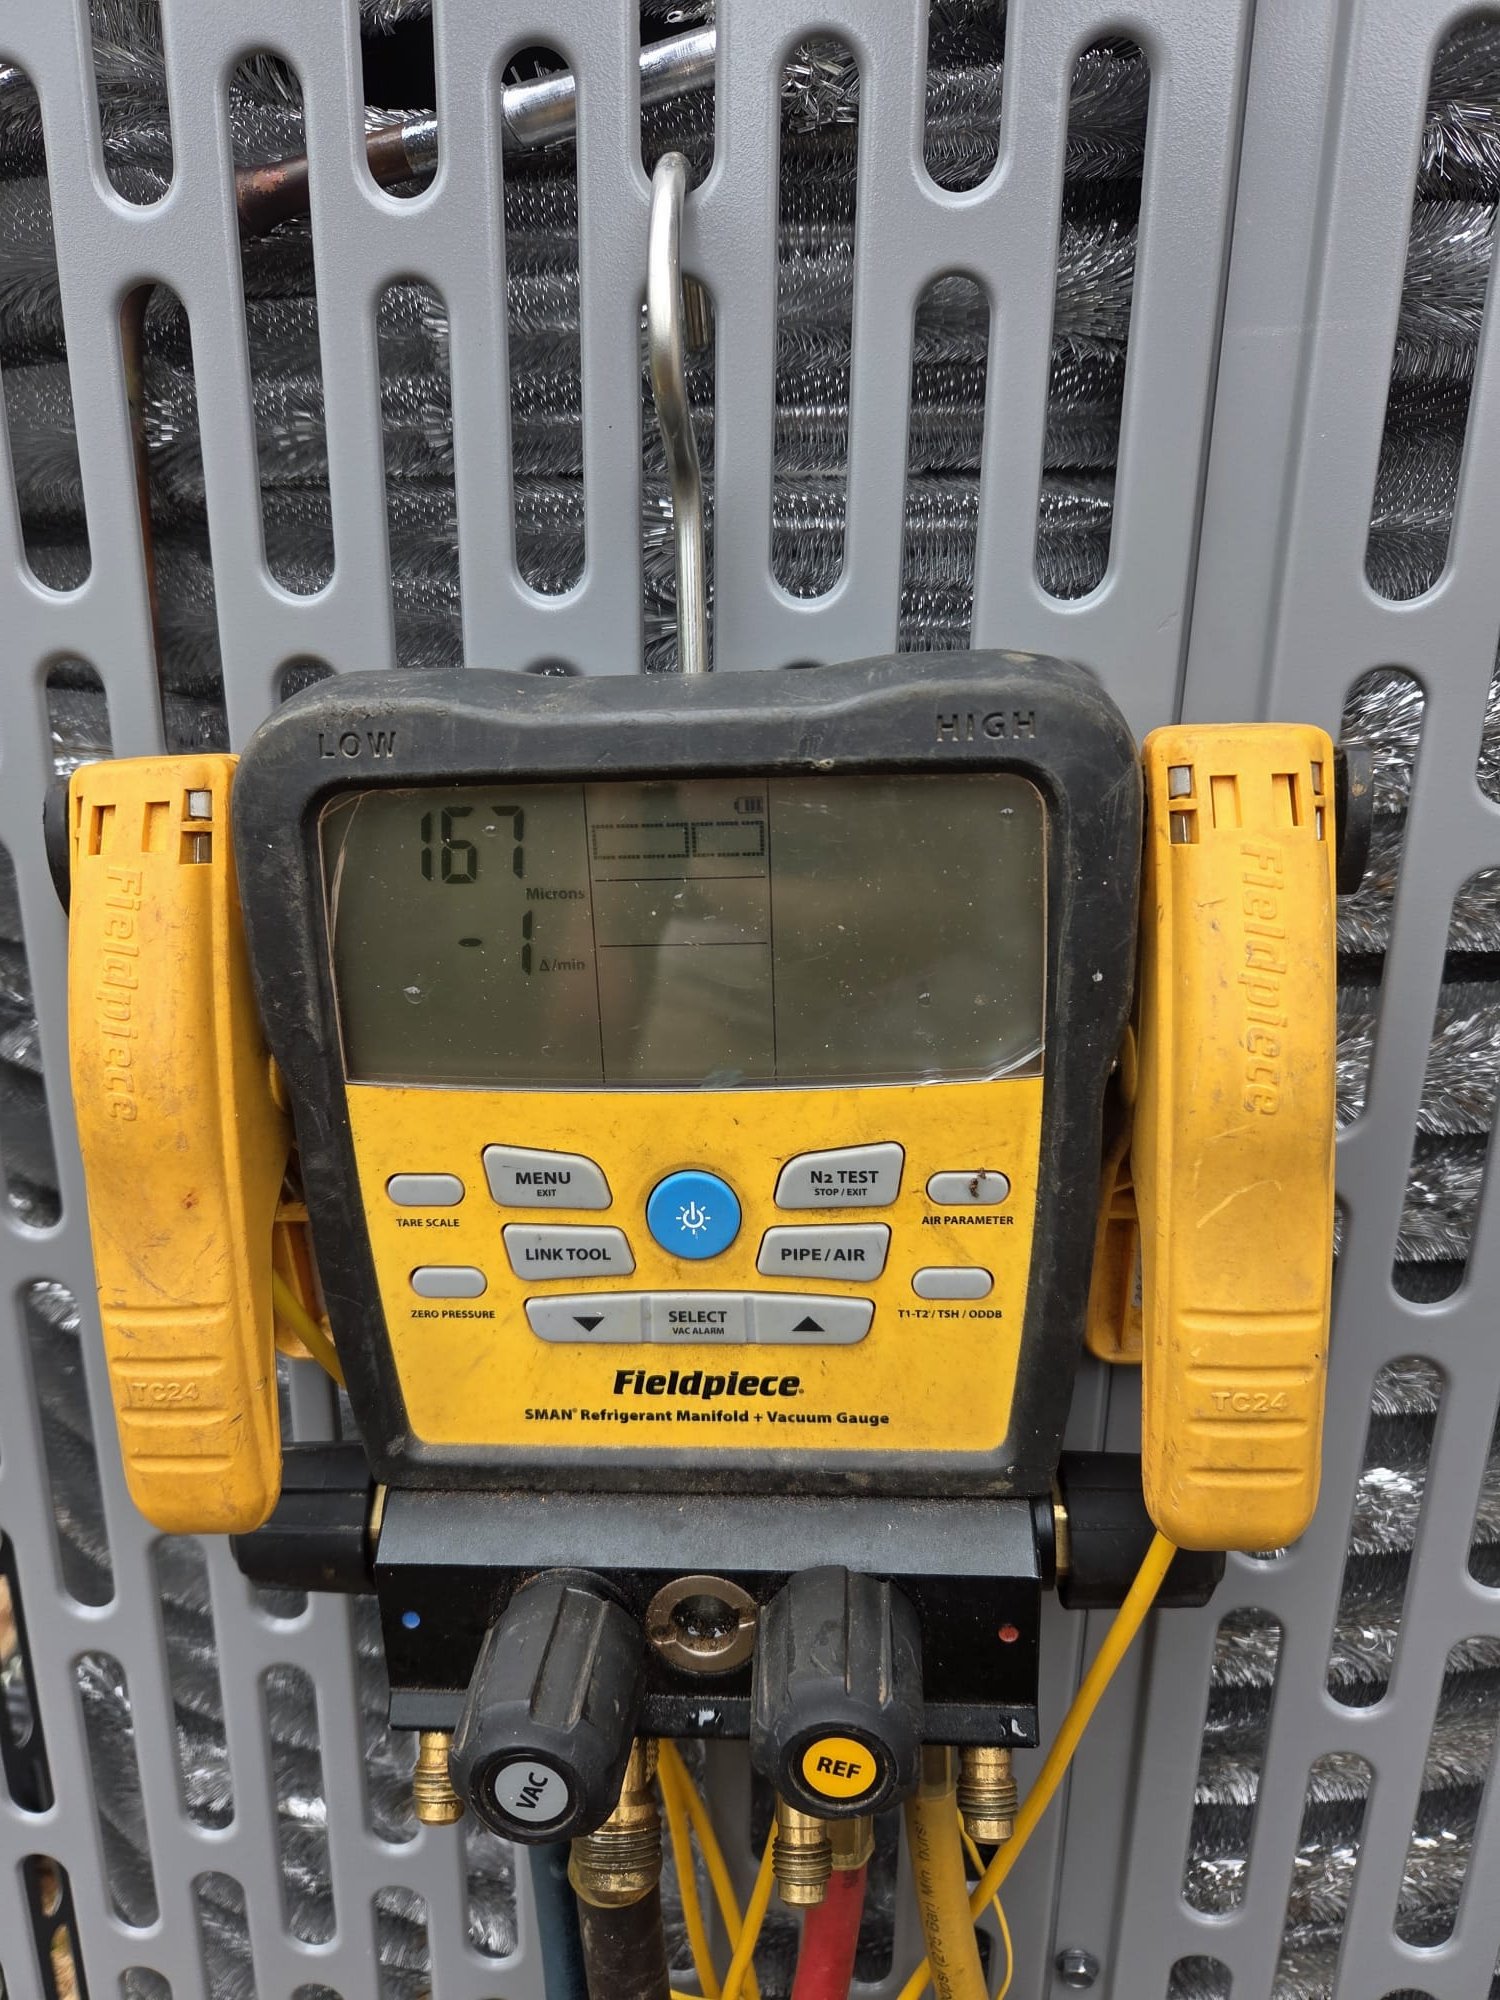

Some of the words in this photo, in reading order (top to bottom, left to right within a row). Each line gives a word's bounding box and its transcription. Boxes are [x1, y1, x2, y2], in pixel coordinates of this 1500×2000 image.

[936, 711, 1036, 742] HIGH
[318, 731, 397, 759] LOW
[421, 806, 524, 884] 167
[525, 887, 586, 900] Microns
[1238, 838, 1288, 1116] Fieldpiece
[96, 864, 142, 1123] Fieldpiece
[515, 1171, 571, 1185] MENU
[837, 1170, 879, 1184] TEST
[537, 1189, 557, 1197] EXIT
[814, 1188, 839, 1196] STOP
[847, 1188, 867, 1196] EXIT
[396, 1218, 423, 1227] TARE
[426, 1218, 460, 1228] SCALE
[922, 1216, 942, 1225] AIR
[944, 1216, 1014, 1226] PARAMETER
[525, 1248, 563, 1261] LINK
[566, 1248, 611, 1261] TOOL
[411, 1310, 439, 1319] ZERO
[441, 1310, 496, 1320] PRESSURE
[668, 1310, 727, 1323] SELECT
[898, 1309, 928, 1318] T1-T2
[939, 1309, 958, 1319] TSH
[969, 1309, 1002, 1319] ODDB
[672, 1327, 690, 1335] VAC
[692, 1327, 725, 1335] ALARM
[132, 1382, 200, 1401] TC24
[613, 1370, 801, 1399] Fieldpiece
[1210, 1391, 1288, 1413] TC24
[581, 1410, 672, 1422] Refrigerant
[676, 1410, 749, 1422] Manifold
[766, 1411, 832, 1424] Vacuum
[836, 1412, 890, 1425] Gauge
[816, 1756, 861, 1779] REF
[516, 1772, 548, 1810] VAC
